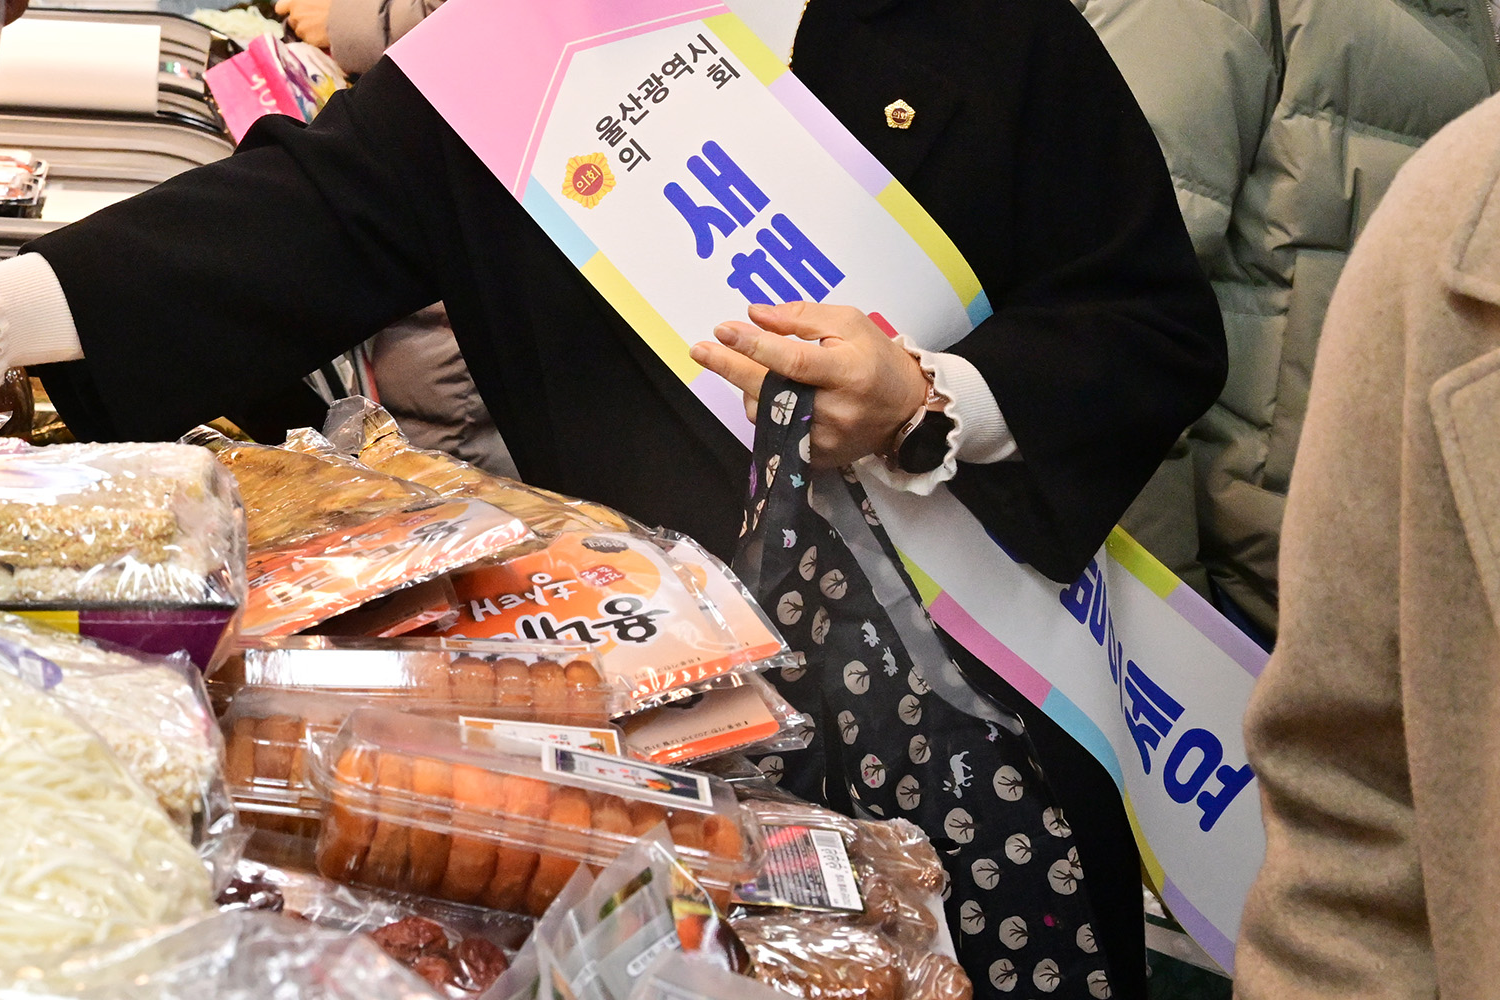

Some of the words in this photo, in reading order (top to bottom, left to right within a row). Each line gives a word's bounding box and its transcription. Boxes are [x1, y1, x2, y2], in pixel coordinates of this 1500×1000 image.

[594, 34, 719, 148] 울산광역시
[575, 164, 602, 194] 의회
[471, 573, 578, 622] 황태
[512, 596, 671, 645] 용대
